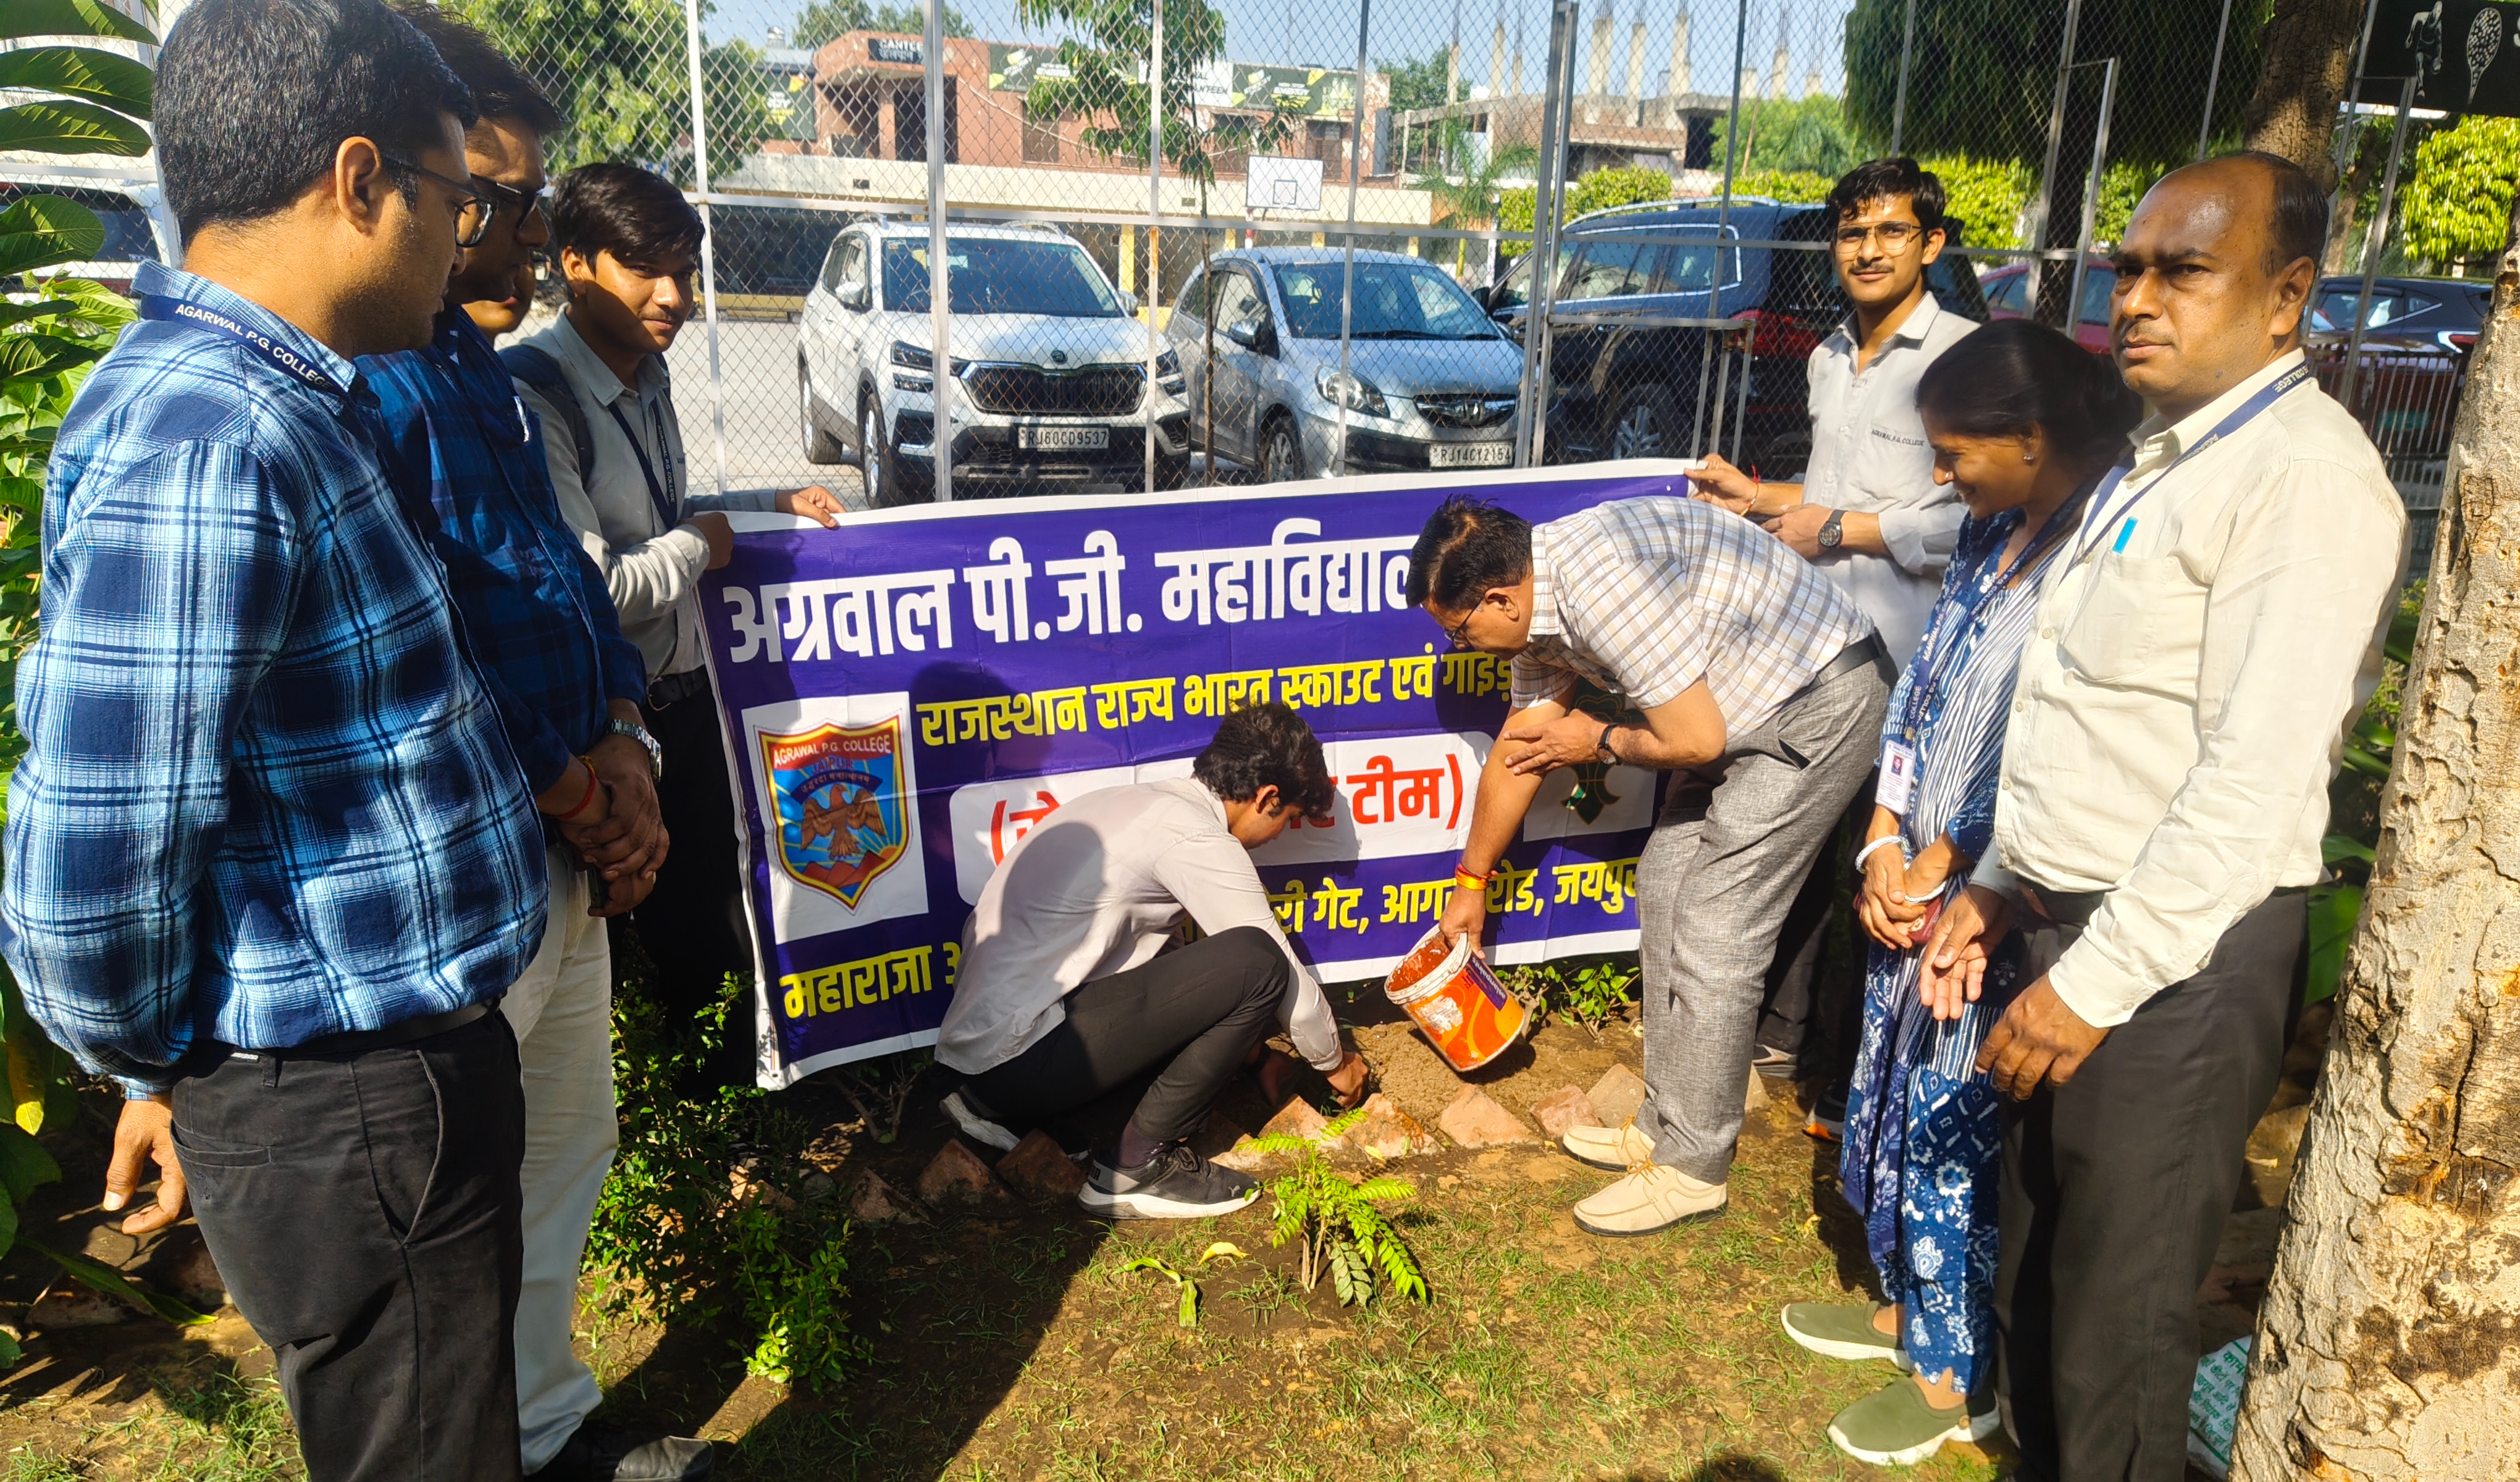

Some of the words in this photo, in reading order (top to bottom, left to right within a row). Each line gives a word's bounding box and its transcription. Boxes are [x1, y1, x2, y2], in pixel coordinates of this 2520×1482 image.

[175, 303, 243, 336] AGARWAL
[246, 330, 270, 351] P.G.
[272, 346, 334, 389] COLLEGE
[1028, 431, 1107, 445] RJ60CD9537
[723, 568, 956, 664] अग्रवाल
[917, 685, 1086, 747] राजस्थान
[1091, 677, 1176, 728] राज्य
[1183, 668, 1274, 717] भारत
[1277, 659, 1386, 710] स्काउट
[1389, 642, 1437, 701] एवं
[1909, 685, 1922, 719] COLLEGE
[773, 743, 820, 768] AGRAWAL
[842, 734, 891, 754] COLLEGE
[1346, 753, 1463, 831] टीम)
[779, 945, 933, 1019] महाराजा
[1312, 877, 1369, 934] गेट,
[1379, 877, 1457, 924] आग
[1485, 860, 1545, 917] रोड,
